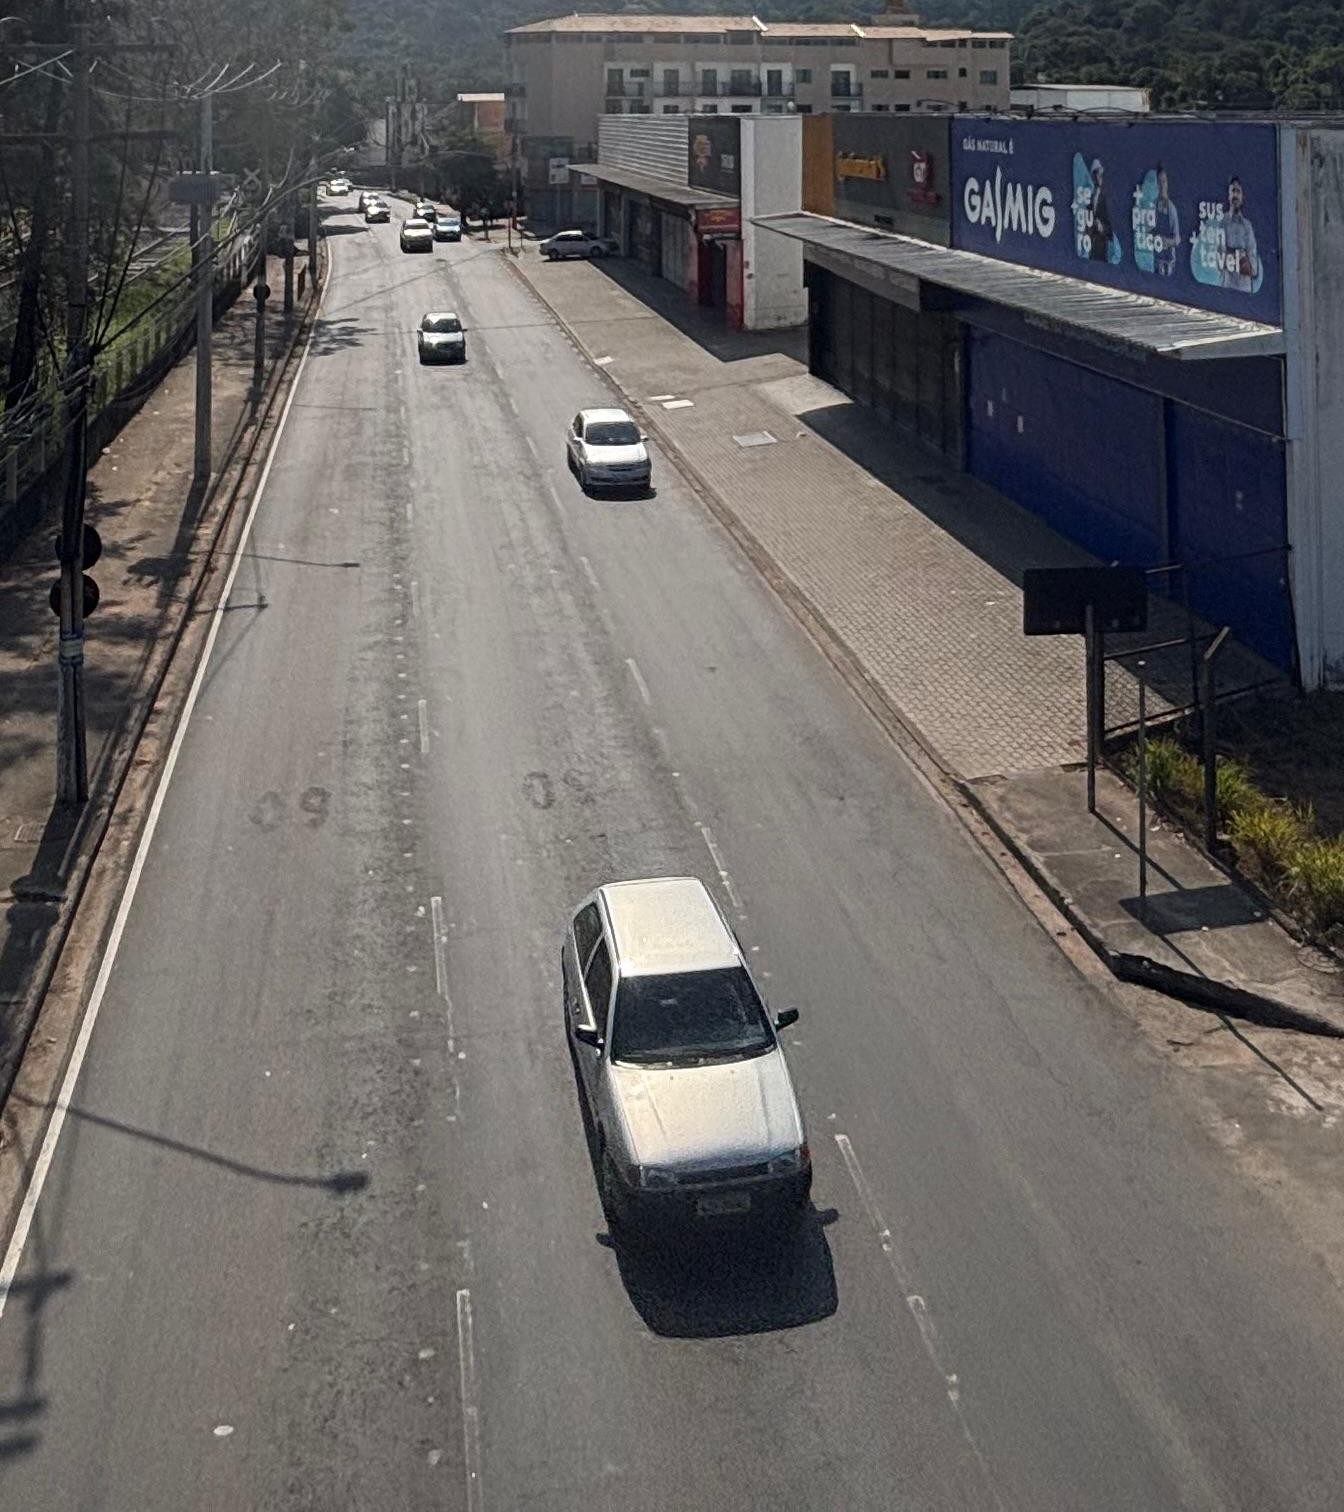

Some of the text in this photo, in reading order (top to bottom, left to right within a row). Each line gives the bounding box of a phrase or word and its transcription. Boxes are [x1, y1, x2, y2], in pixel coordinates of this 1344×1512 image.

[964, 165, 1056, 244] GASMIG
[1076, 186, 1092, 204] se
[1077, 208, 1093, 232] gu
[1199, 201, 1224, 221] sus
[1200, 220, 1226, 250] ten
